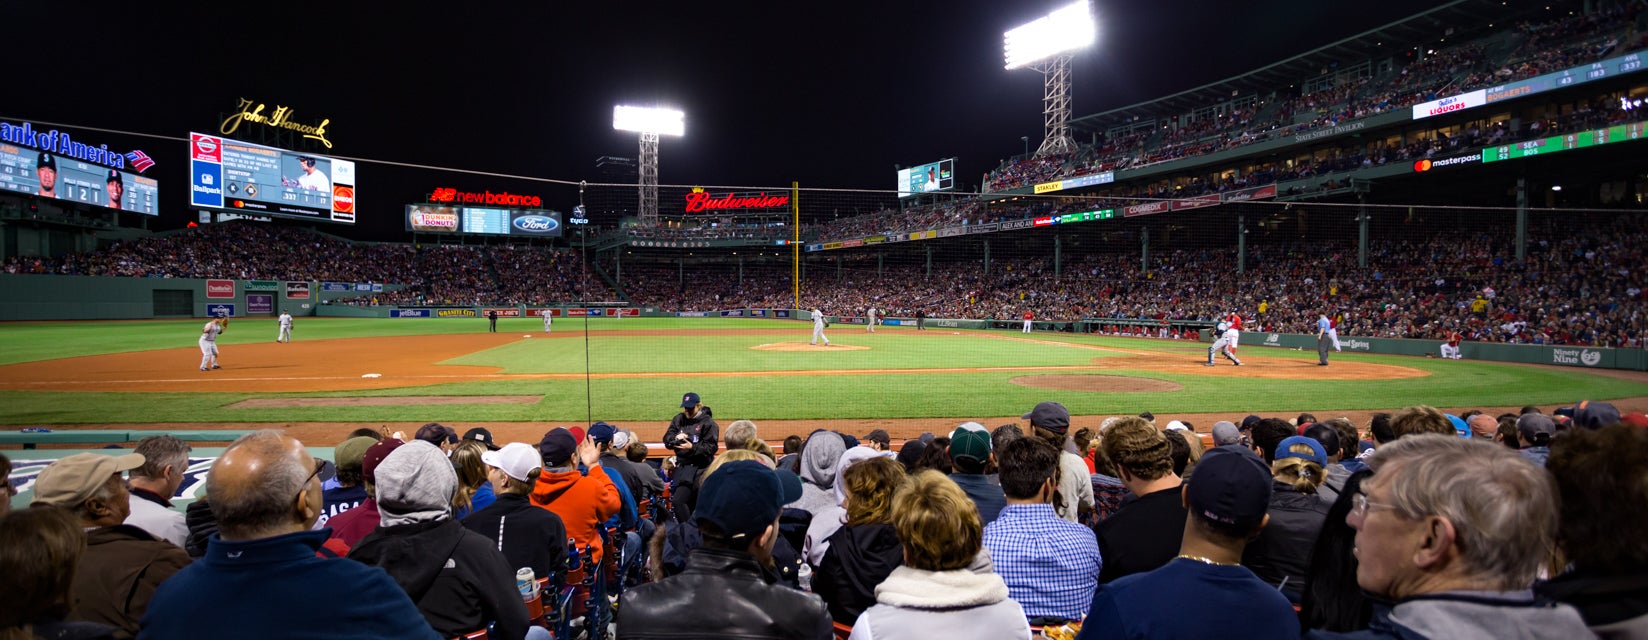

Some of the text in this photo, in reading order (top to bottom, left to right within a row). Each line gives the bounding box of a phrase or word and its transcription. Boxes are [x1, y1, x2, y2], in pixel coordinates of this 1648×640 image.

[1620, 60, 1640, 72] .337
[1590, 69, 1605, 78] 183
[1487, 86, 1530, 102] BOGAERTS
[1430, 102, 1465, 115] LIQUORS
[221, 97, 332, 148] John Hancock
[1296, 122, 1365, 142] STATE STREET PAVILION
[38, 130, 58, 152] of
[60, 132, 124, 169] America
[1433, 153, 1481, 167] masterpass
[69, 186, 98, 203] 1 2 1
[193, 185, 222, 194] Ballpark
[457, 192, 485, 203] new
[485, 190, 541, 206] balance
[686, 191, 789, 212] Budweiser
[1129, 202, 1162, 214] COGMEDIX
[522, 218, 550, 230] Ford
[1350, 340, 1369, 350] Spring
[1554, 355, 1578, 363] Nine
